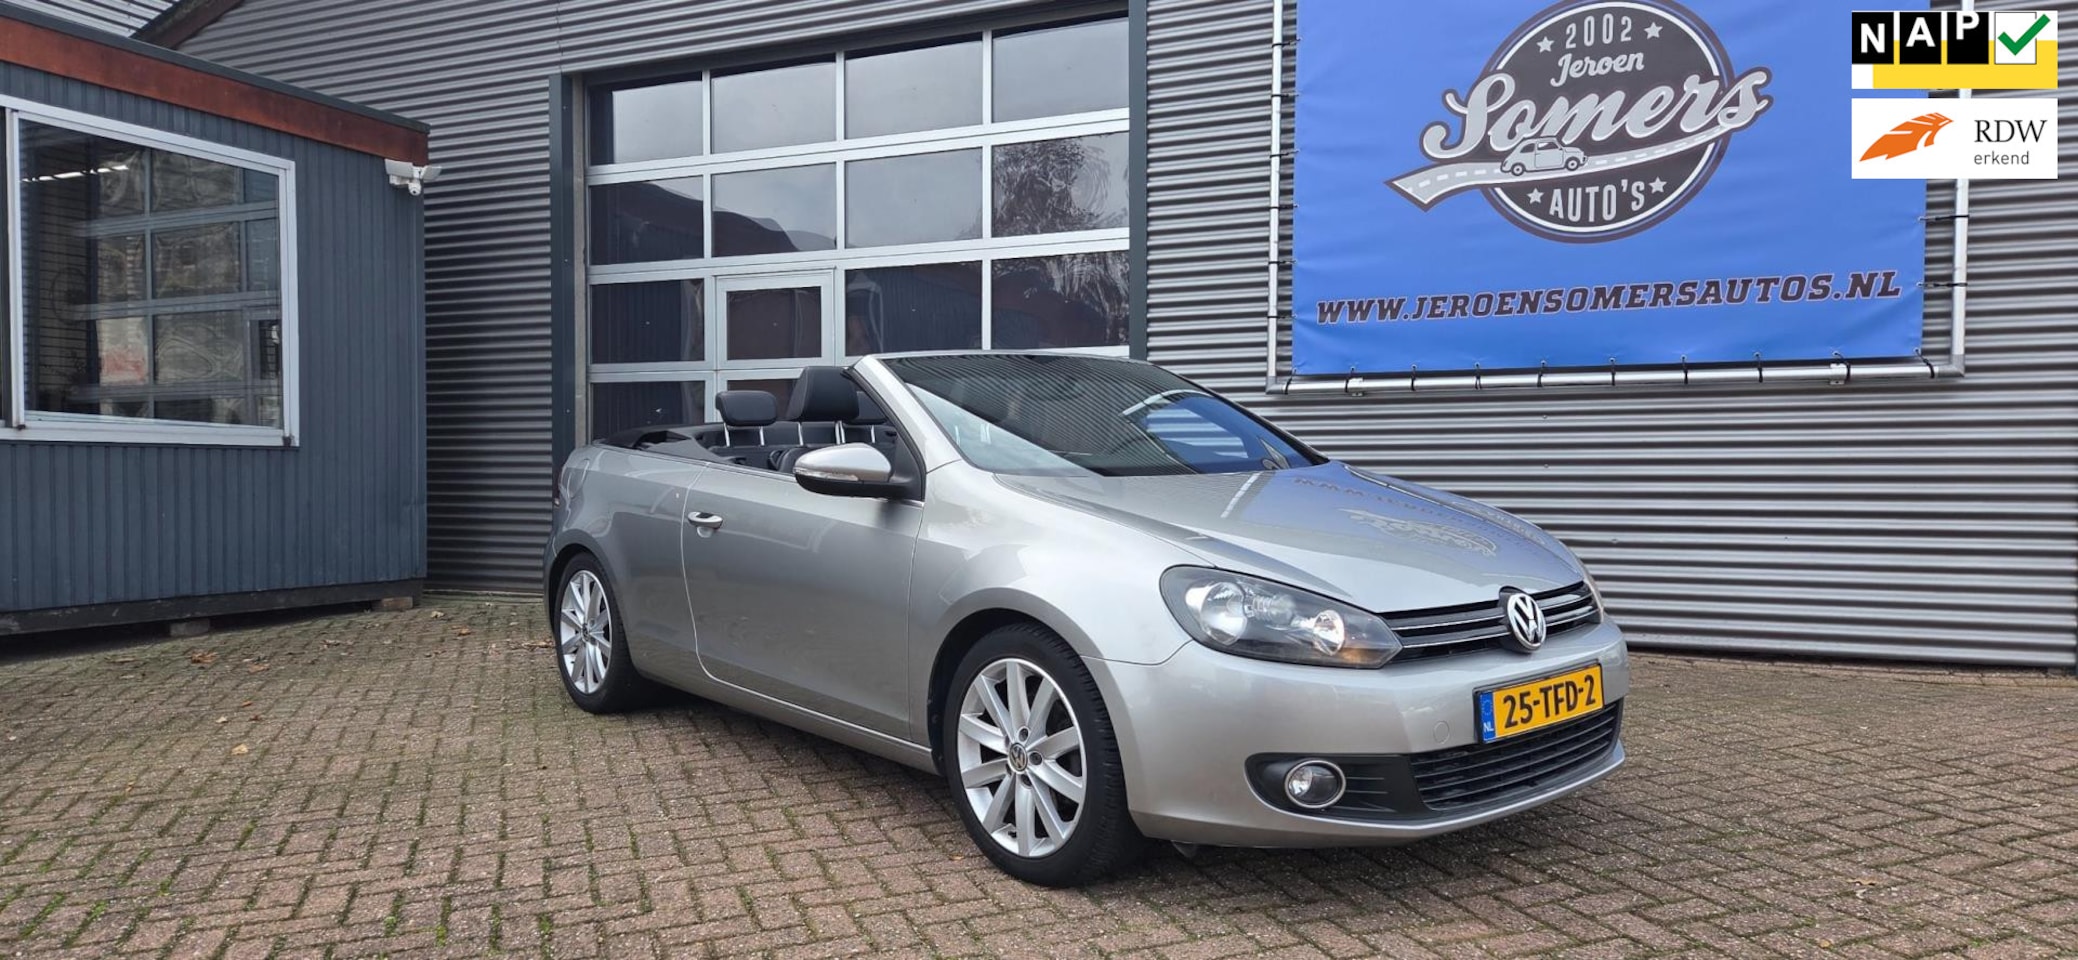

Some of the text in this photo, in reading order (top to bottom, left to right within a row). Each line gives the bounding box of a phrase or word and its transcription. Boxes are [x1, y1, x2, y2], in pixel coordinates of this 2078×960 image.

[1565, 13, 1632, 49] 2002
[1550, 52, 1645, 87] Jeroen
[1422, 71, 1769, 158] Somers
[1549, 179, 1645, 222] AUTO'S
[1316, 270, 1903, 325] WWW.JEROENSOMERSAUTOS.NL
[1503, 674, 1596, 729] 25-TFD-2
[1483, 722, 1494, 733] NL
